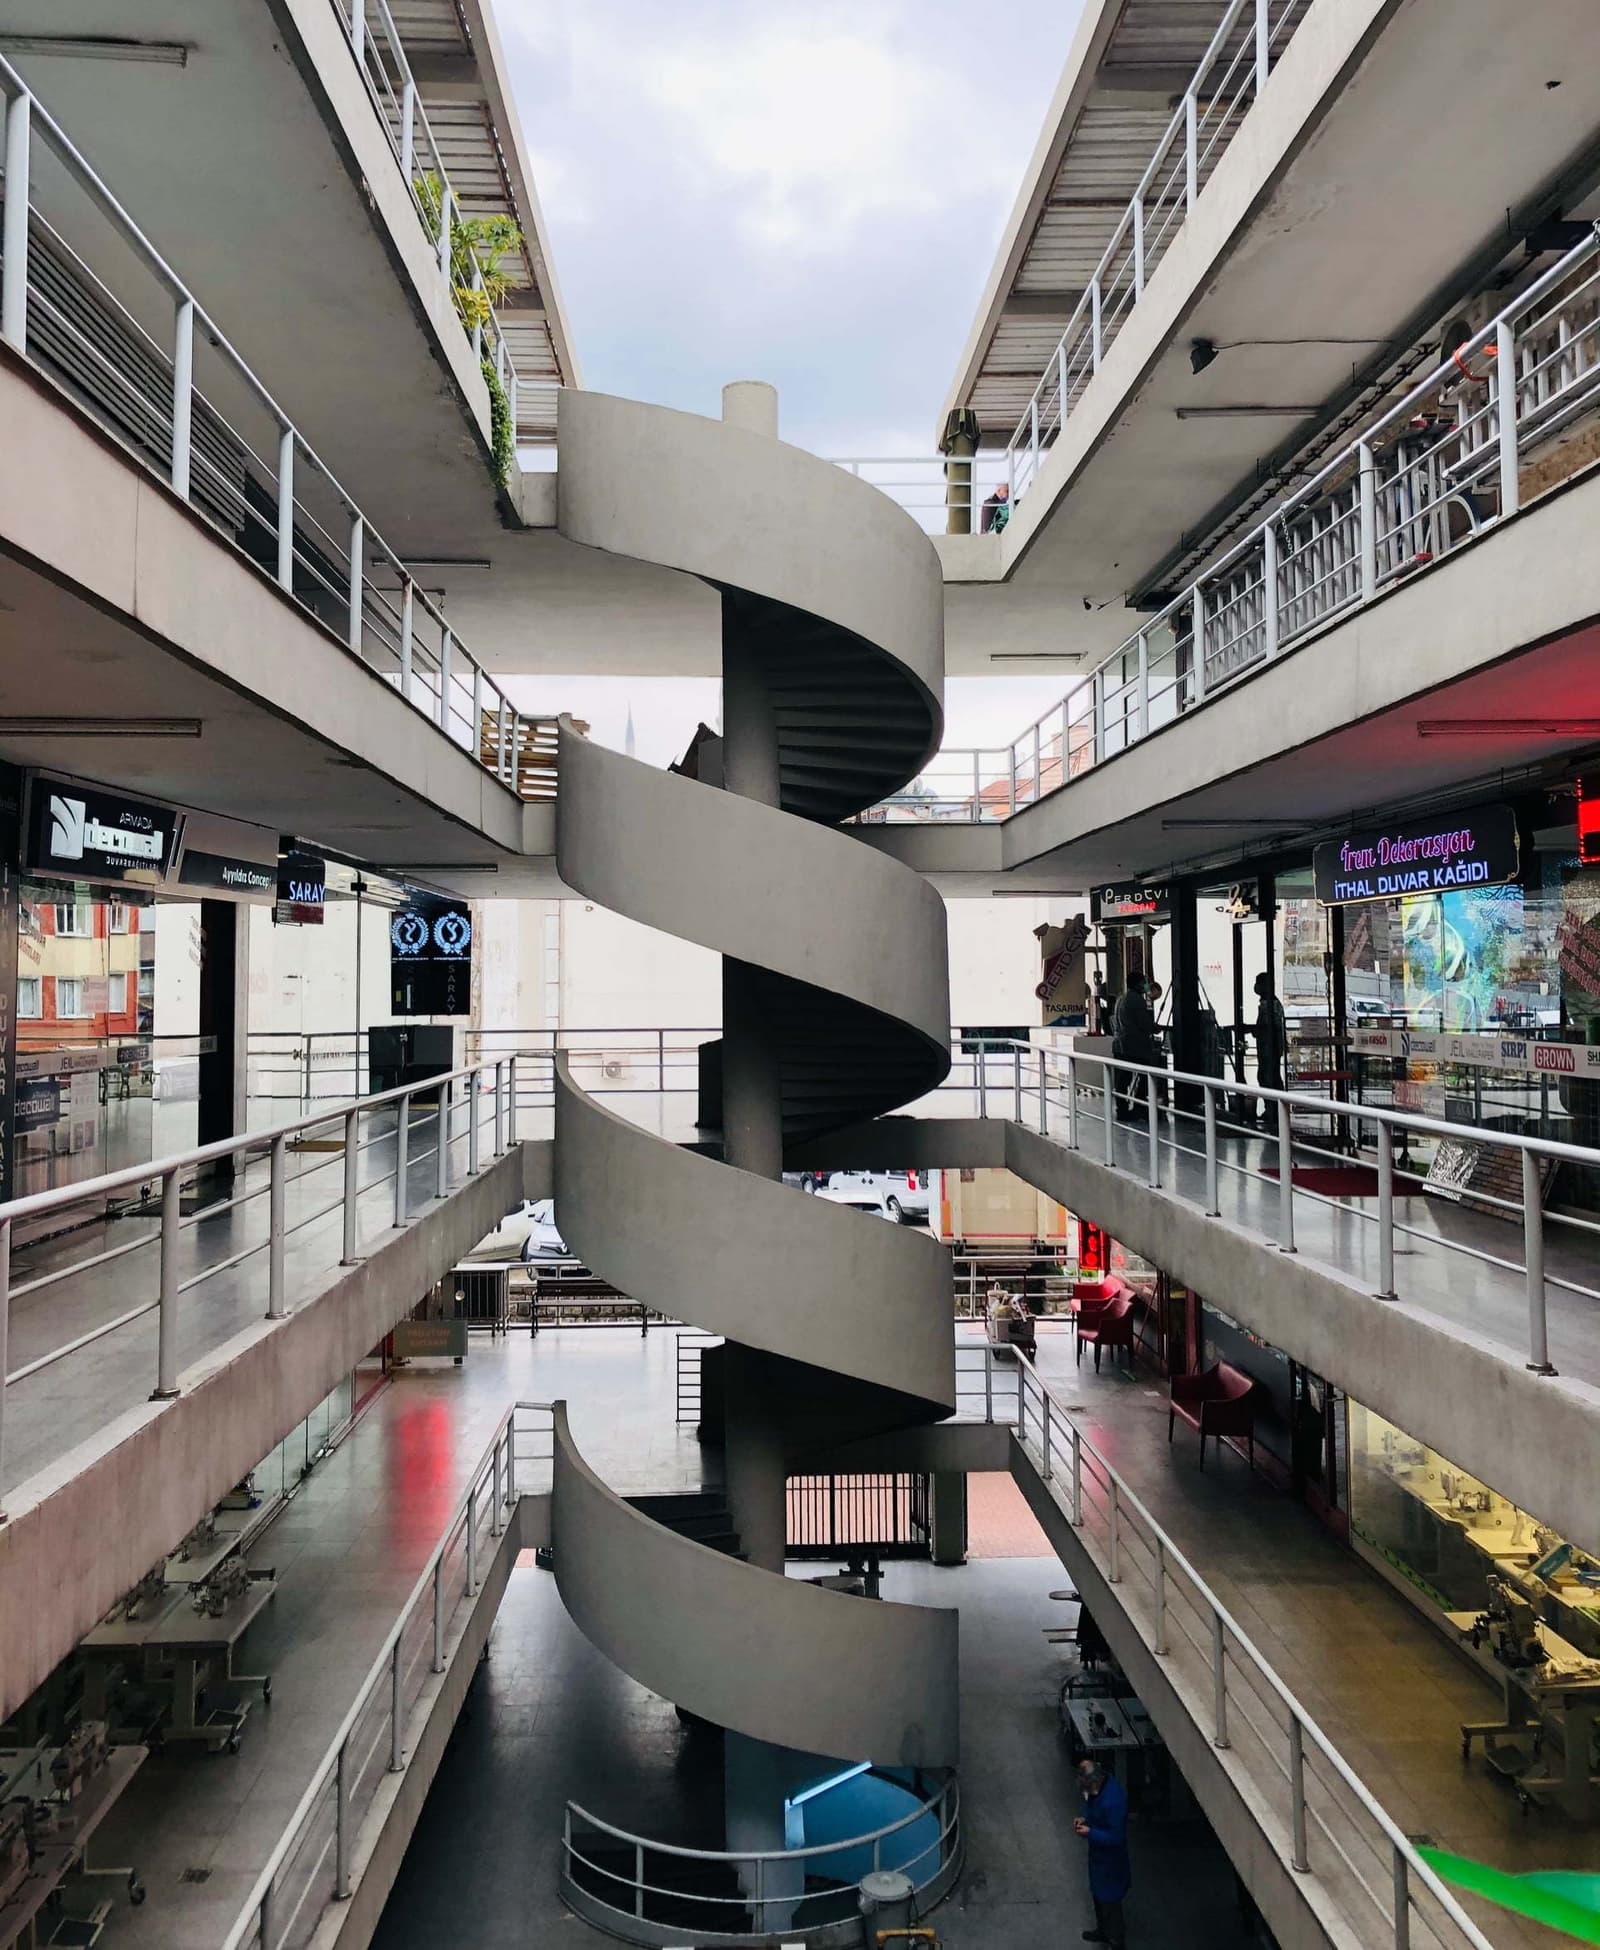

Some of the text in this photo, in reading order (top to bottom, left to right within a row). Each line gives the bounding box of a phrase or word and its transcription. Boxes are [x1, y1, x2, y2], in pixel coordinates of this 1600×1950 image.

[1377, 829, 1476, 866] Dekorasyon
[1335, 859, 1489, 899] İTHAL DUVAR KAĞIDI
[289, 881, 326, 903] SARAY
[447, 964, 456, 1012] SARAY
[1501, 1041, 1527, 1059] SIRPI
[1535, 1048, 1575, 1070] GROWN
[14, 1095, 55, 1116] decowall
